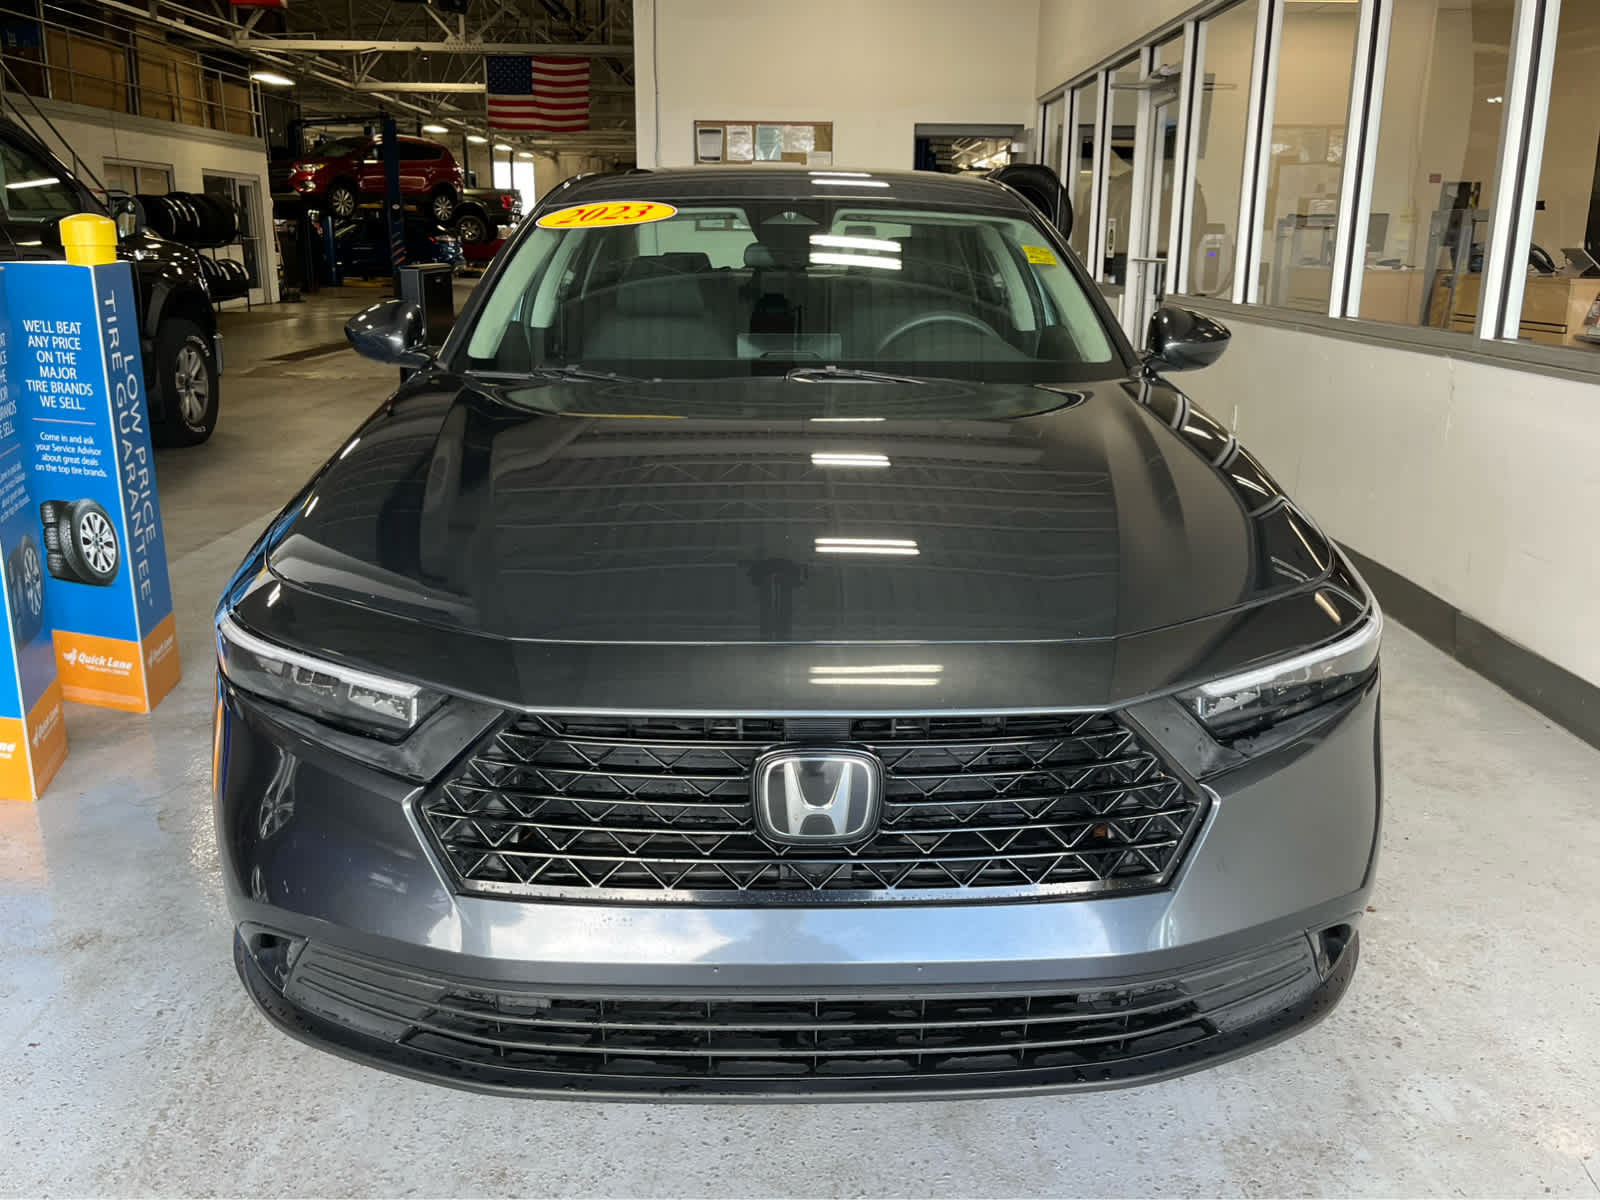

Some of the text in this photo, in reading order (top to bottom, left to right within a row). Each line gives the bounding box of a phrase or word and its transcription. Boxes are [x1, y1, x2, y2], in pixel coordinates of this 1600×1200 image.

[555, 204, 654, 224] 2023
[23, 320, 82, 335] WE'LL BEAT
[105, 289, 123, 372] TIRE
[28, 335, 82, 350] ANY PRICE
[36, 351, 77, 365] ON THE
[40, 365, 77, 380] MAJOR
[25, 379, 49, 393] TIRE
[51, 381, 94, 396] BRANDS
[40, 395, 57, 408] WE
[40, 432, 60, 442] Come
[61, 433, 68, 442] in
[69, 435, 82, 444] and
[35, 444, 51, 452] your
[52, 443, 76, 453] Service
[124, 354, 156, 542] LOW PRICE
[42, 453, 62, 462] about
[63, 456, 81, 465] great
[45, 464, 57, 472] the
[57, 465, 71, 475] top
[78, 652, 106, 666] Quick
[107, 657, 133, 671] Lane
